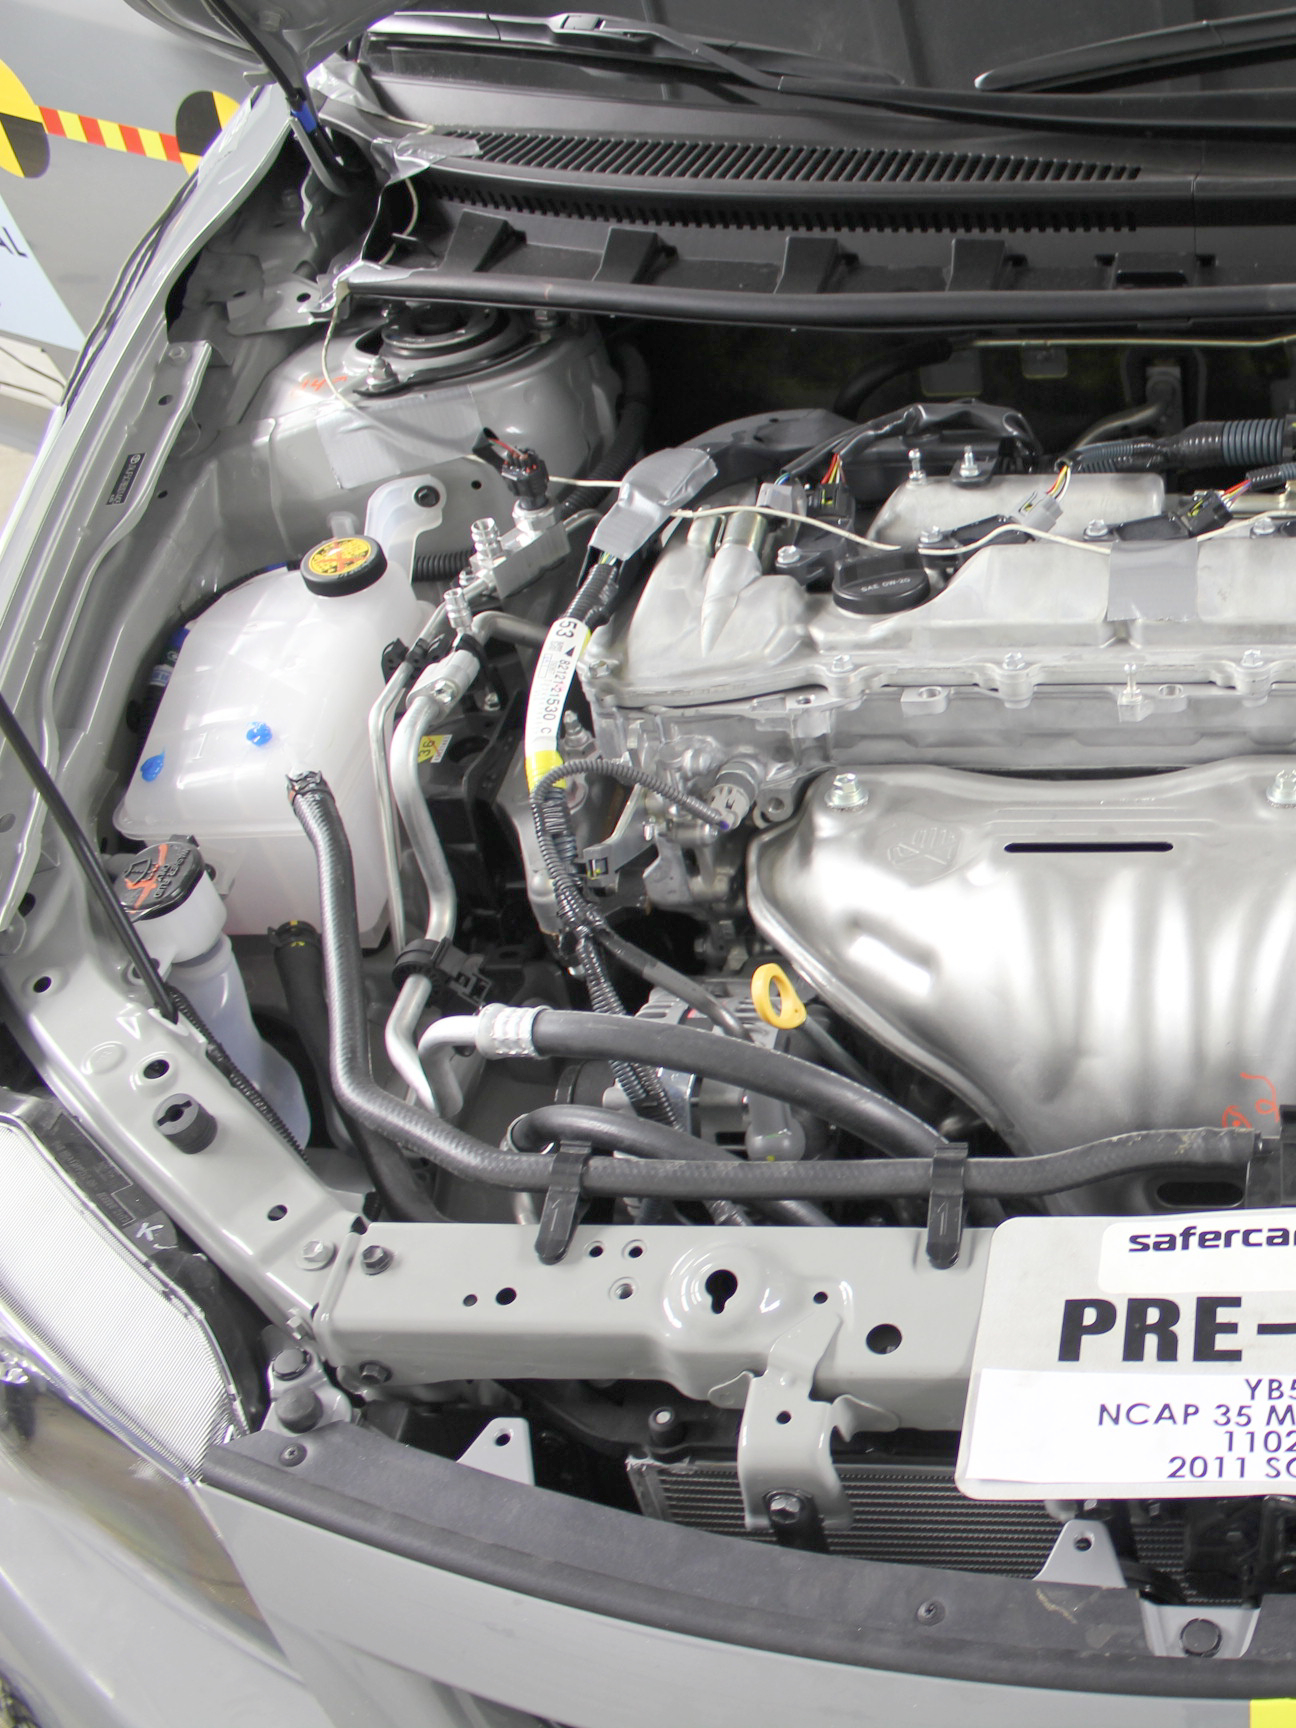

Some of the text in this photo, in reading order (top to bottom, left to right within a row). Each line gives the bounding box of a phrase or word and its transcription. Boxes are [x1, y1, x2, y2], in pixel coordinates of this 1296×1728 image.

[860, 583, 880, 593] SAE
[556, 620, 578, 639] 53
[1098, 1403, 1200, 1426] NCAP
[1214, 1404, 1252, 1427] 35
[1167, 1456, 1245, 1478] 2011
